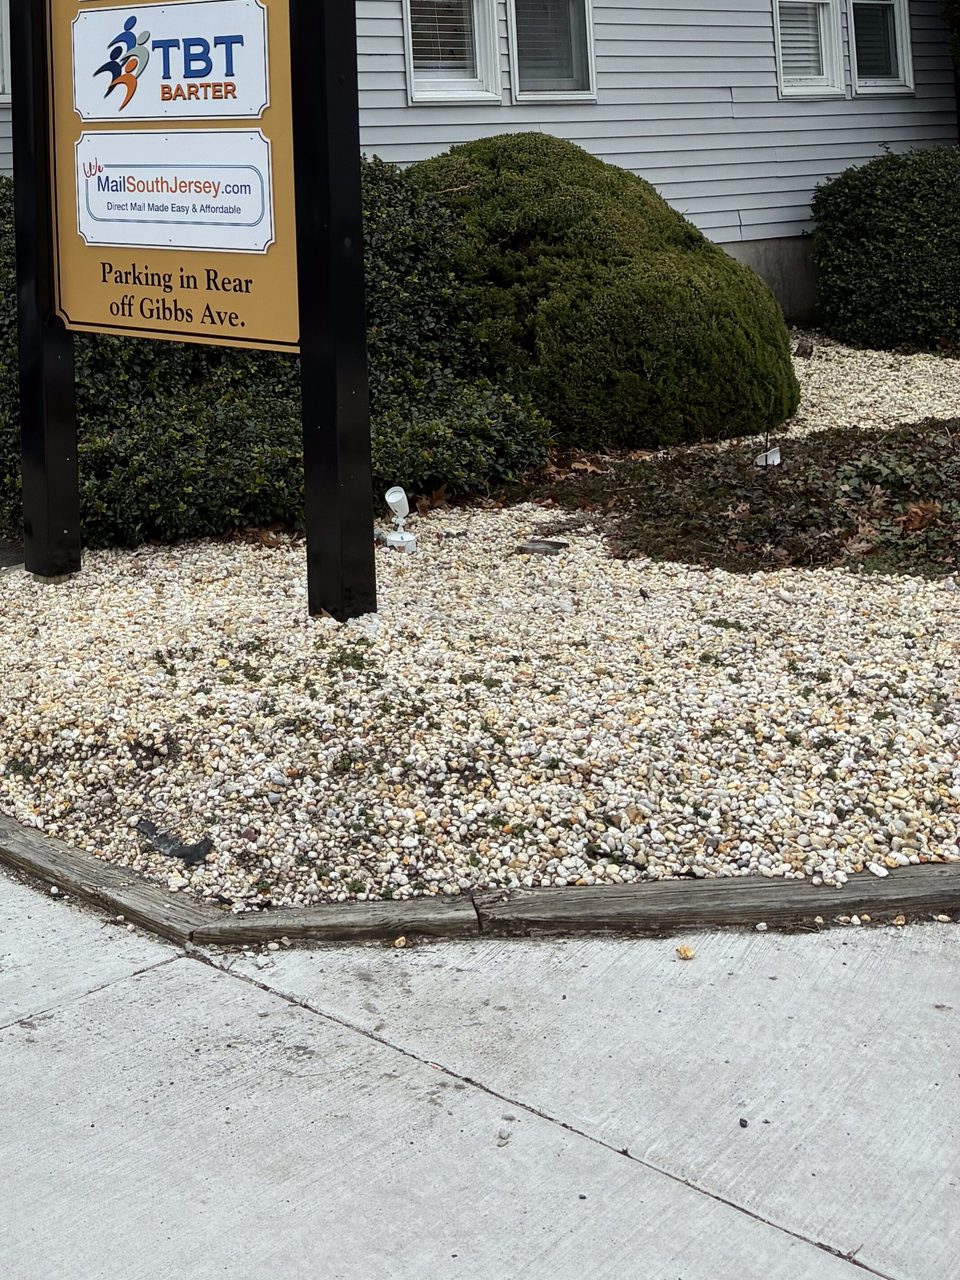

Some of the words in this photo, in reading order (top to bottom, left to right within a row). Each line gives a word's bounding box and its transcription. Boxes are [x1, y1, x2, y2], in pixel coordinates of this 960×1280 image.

[152, 34, 244, 80] TBT
[160, 81, 238, 101] BARTER
[83, 157, 104, 178] We
[97, 175, 251, 198] MailSouthJersey.com
[106, 201, 128, 211] Direct
[130, 202, 145, 212] Mail
[147, 202, 169, 213] Made
[171, 203, 190, 214] Easy
[192, 204, 197, 213] &
[199, 204, 241, 214] Affordable
[100, 262, 173, 293] Parking
[179, 267, 198, 290] in
[205, 268, 253, 294] Rear
[109, 295, 135, 317] off
[139, 297, 193, 323] Gibbs
[200, 303, 246, 328] Ave.
